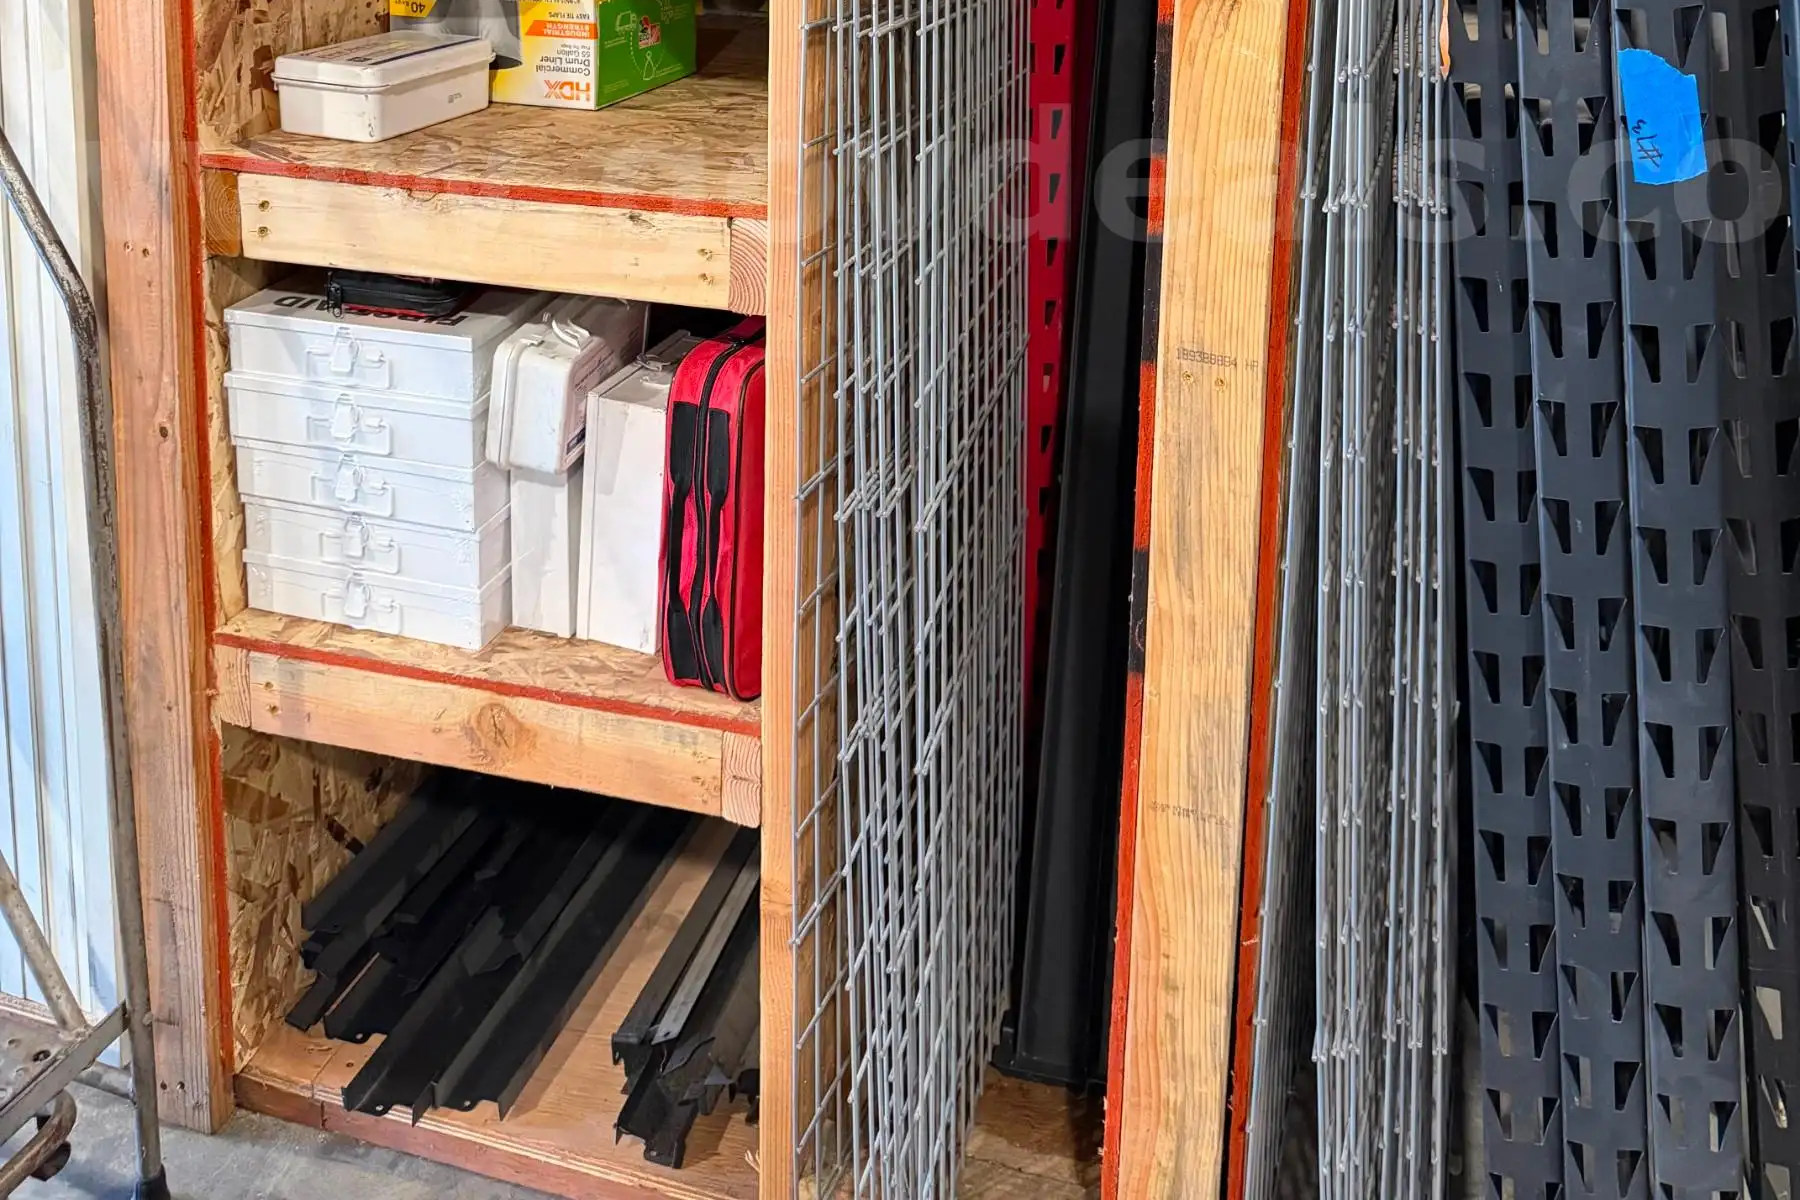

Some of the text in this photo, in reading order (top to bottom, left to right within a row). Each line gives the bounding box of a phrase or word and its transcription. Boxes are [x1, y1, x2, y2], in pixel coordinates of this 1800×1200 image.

[410, 1, 426, 14] 40
[543, 28, 590, 38] INDUSTRIAL
[545, 22, 590, 31] STRENGTH
[556, 48, 580, 58] Gallon
[540, 55, 591, 67] Drum Liner
[535, 64, 591, 77] Commercial
[543, 79, 591, 102] HDX
[1631, 119, 1664, 168] #13
[274, 296, 332, 312] AID
